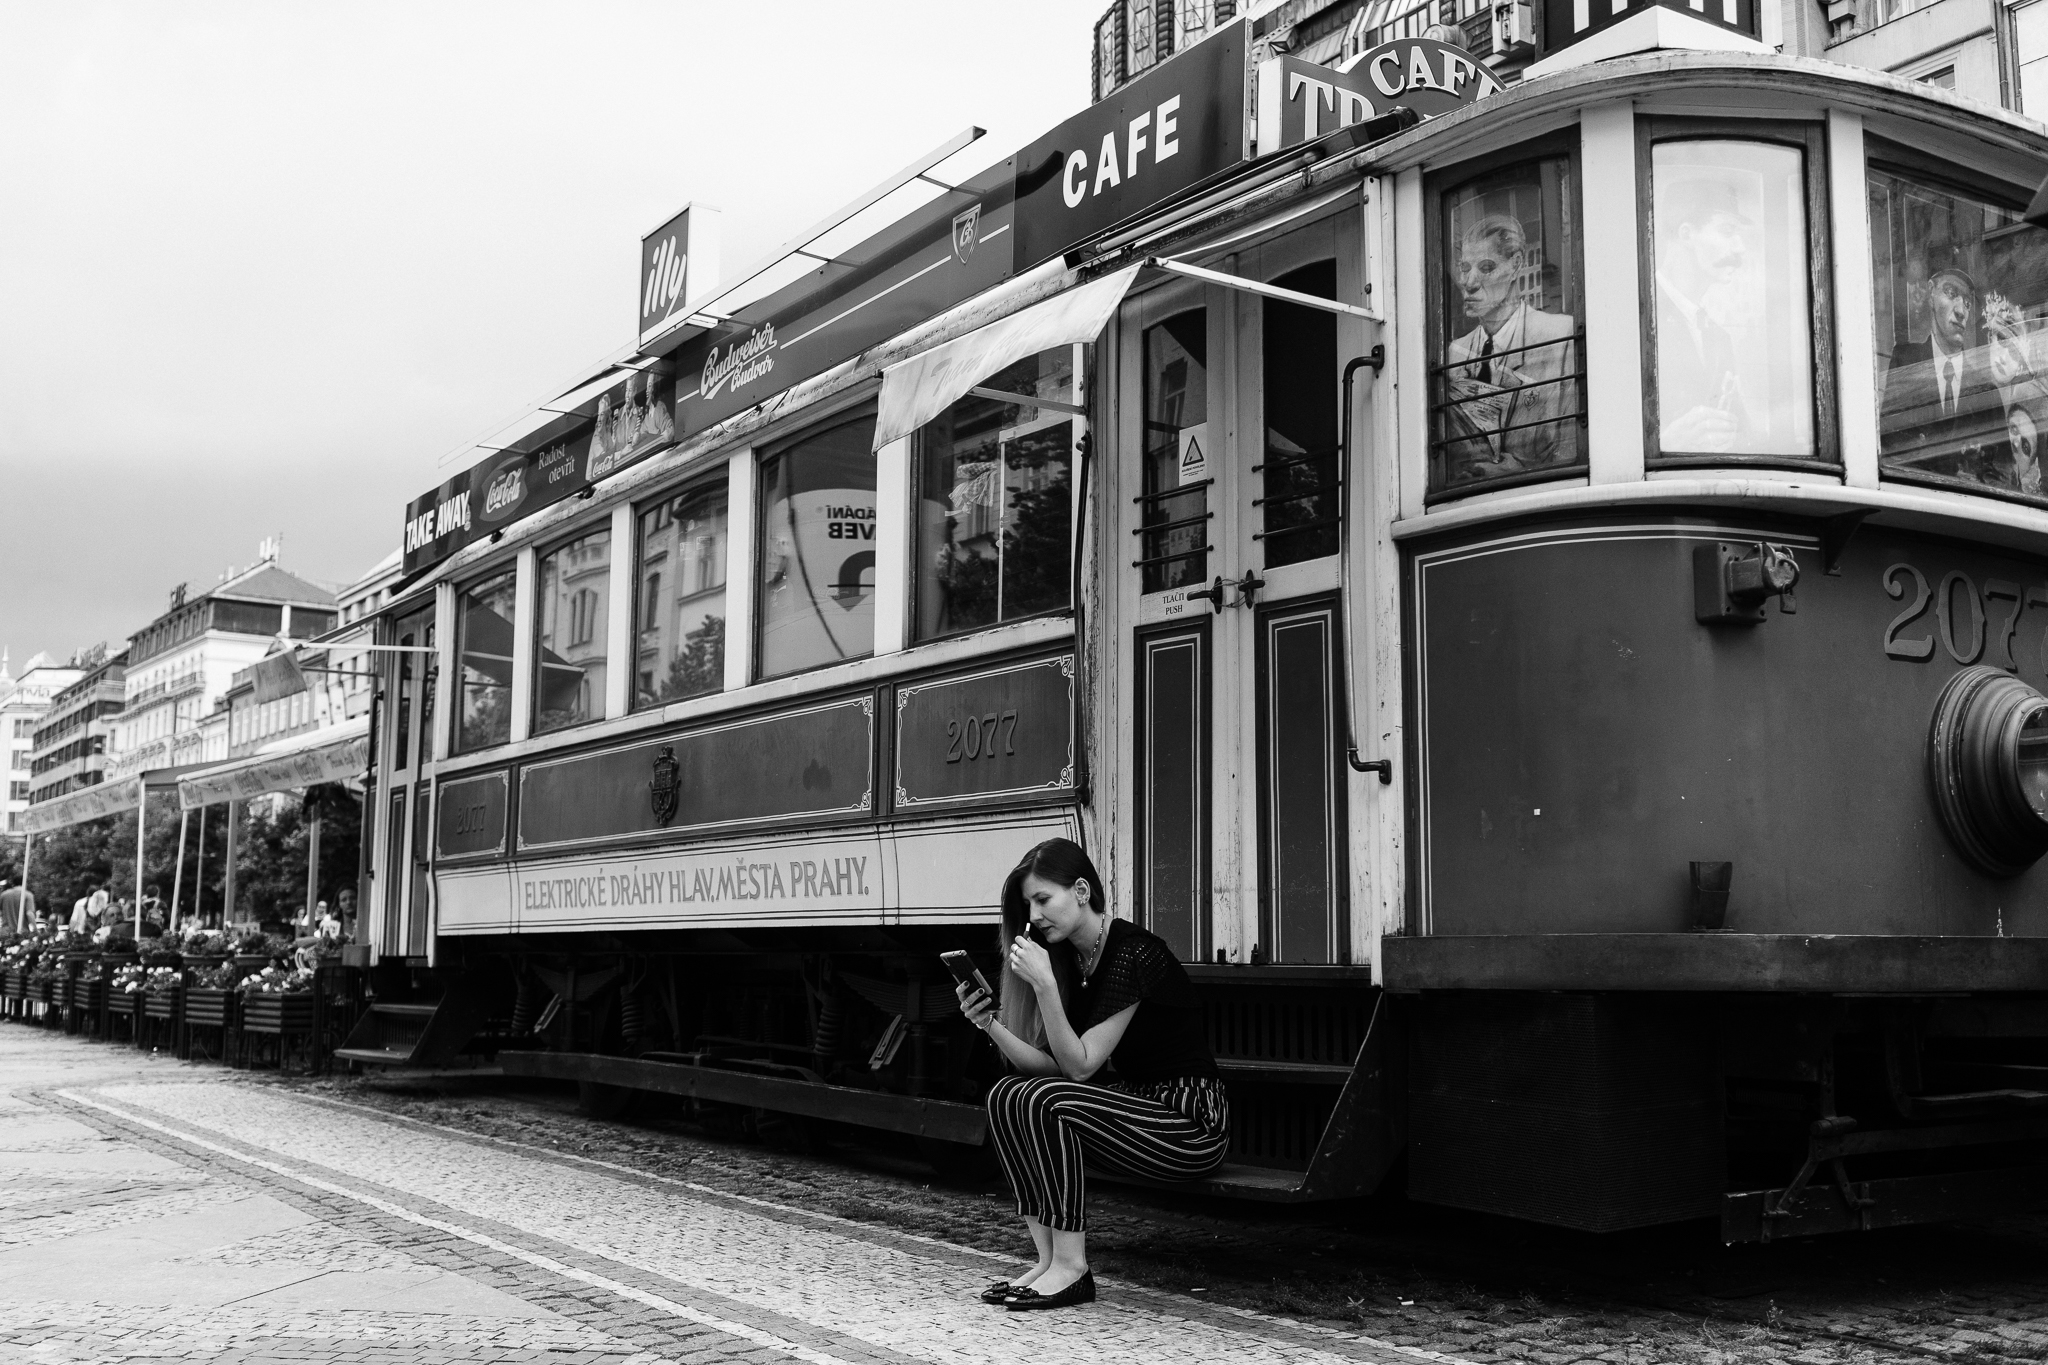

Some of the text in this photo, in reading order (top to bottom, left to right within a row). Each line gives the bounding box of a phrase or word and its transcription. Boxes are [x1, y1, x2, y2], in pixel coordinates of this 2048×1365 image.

[1063, 94, 1180, 209] CAFE
[644, 235, 687, 320] illy
[701, 322, 777, 397] Budweiser
[730, 354, 775, 393] Budvar
[538, 442, 566, 470] Radost
[406, 489, 470, 555] TAKE AWAY
[1165, 604, 1183, 615] PUSH
[946, 709, 1019, 763] 2077
[456, 803, 487, 835] 2077
[525, 867, 607, 910] ELEKTRICKÉ
[610, 865, 665, 907] DRÁHY
[790, 856, 870, 899] PRAHY.
